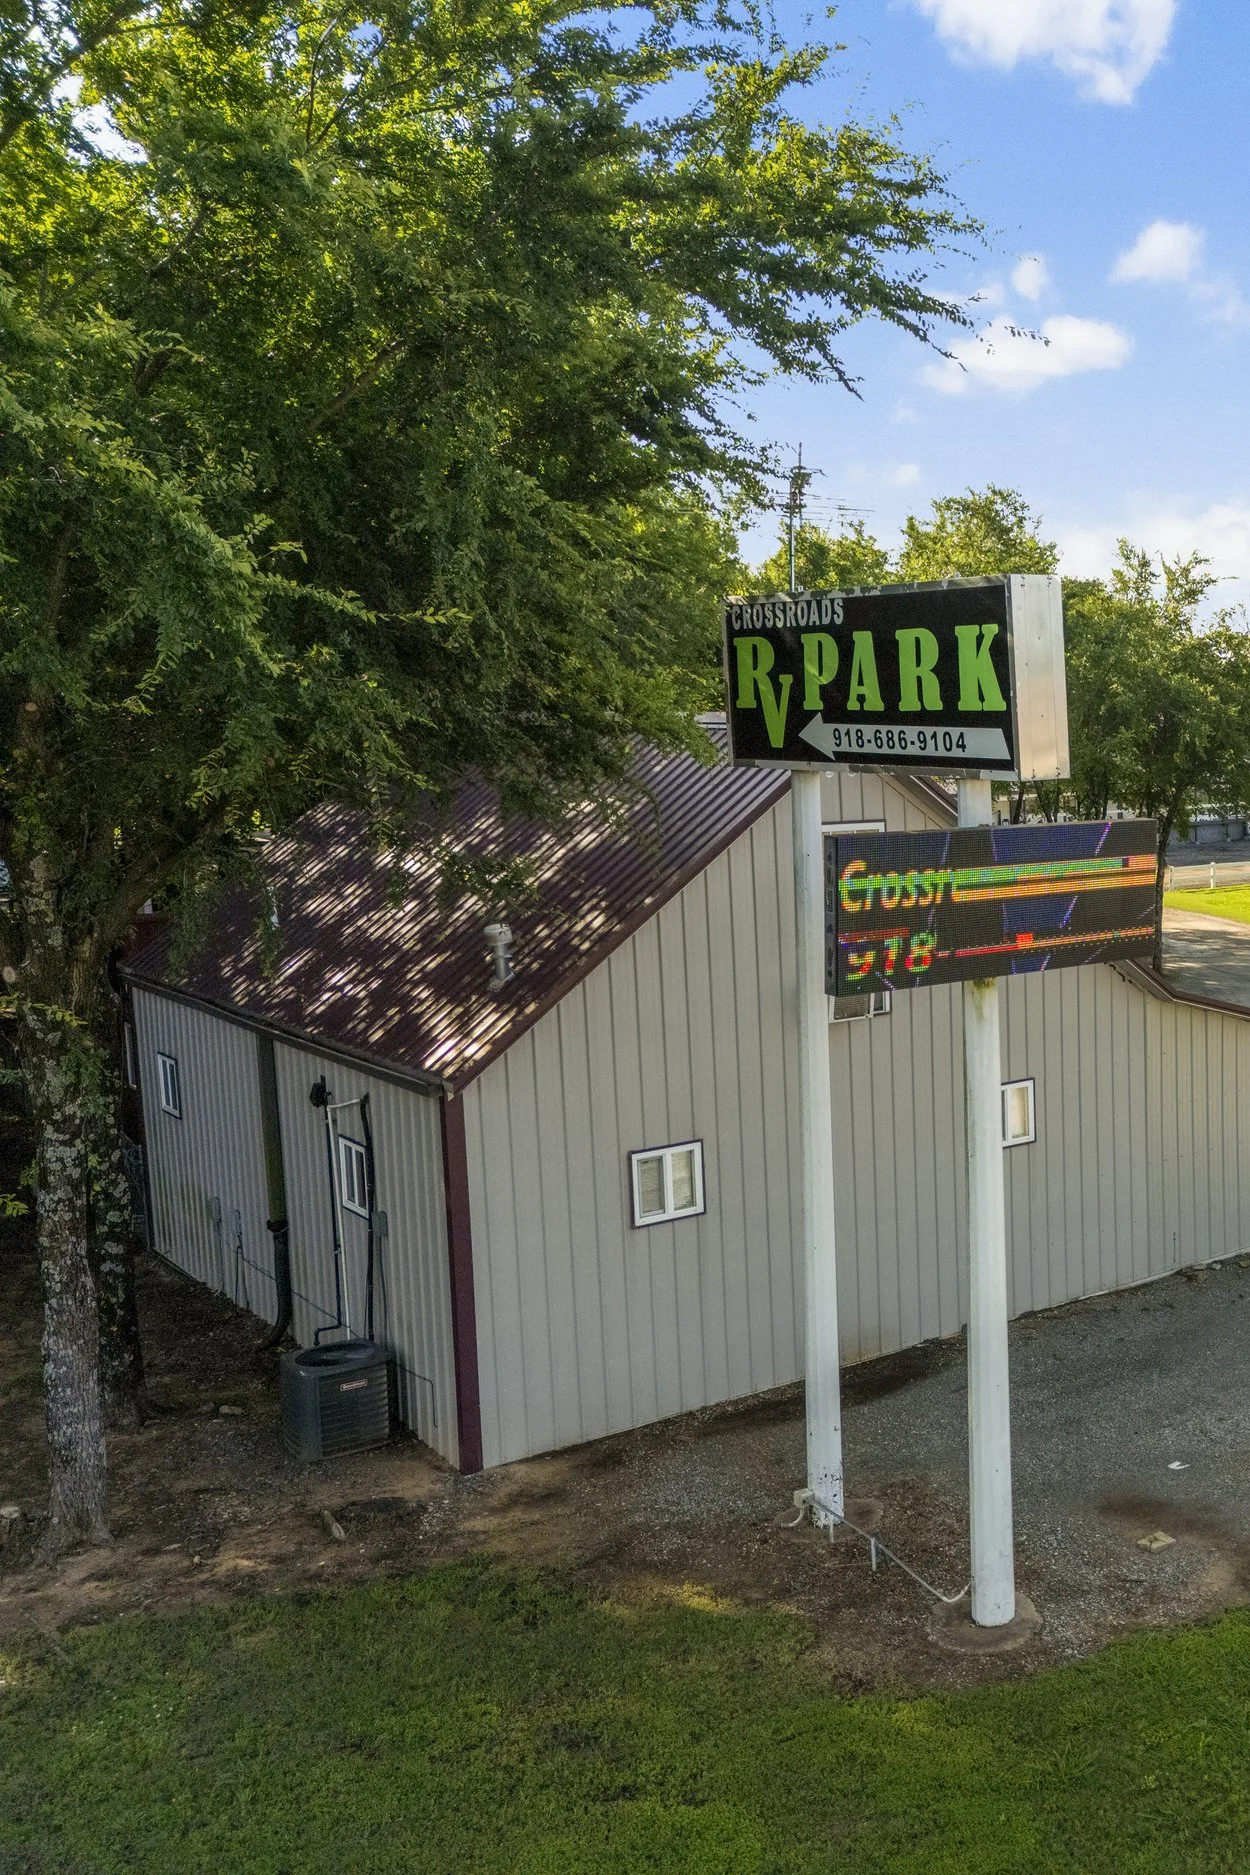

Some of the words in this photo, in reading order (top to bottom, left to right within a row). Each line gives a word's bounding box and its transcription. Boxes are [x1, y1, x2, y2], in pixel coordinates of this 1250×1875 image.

[732, 598, 844, 630] CROSSROADS
[733, 636, 793, 748] RV
[801, 623, 1007, 712] PARK
[833, 727, 967, 753] 918-686-9104
